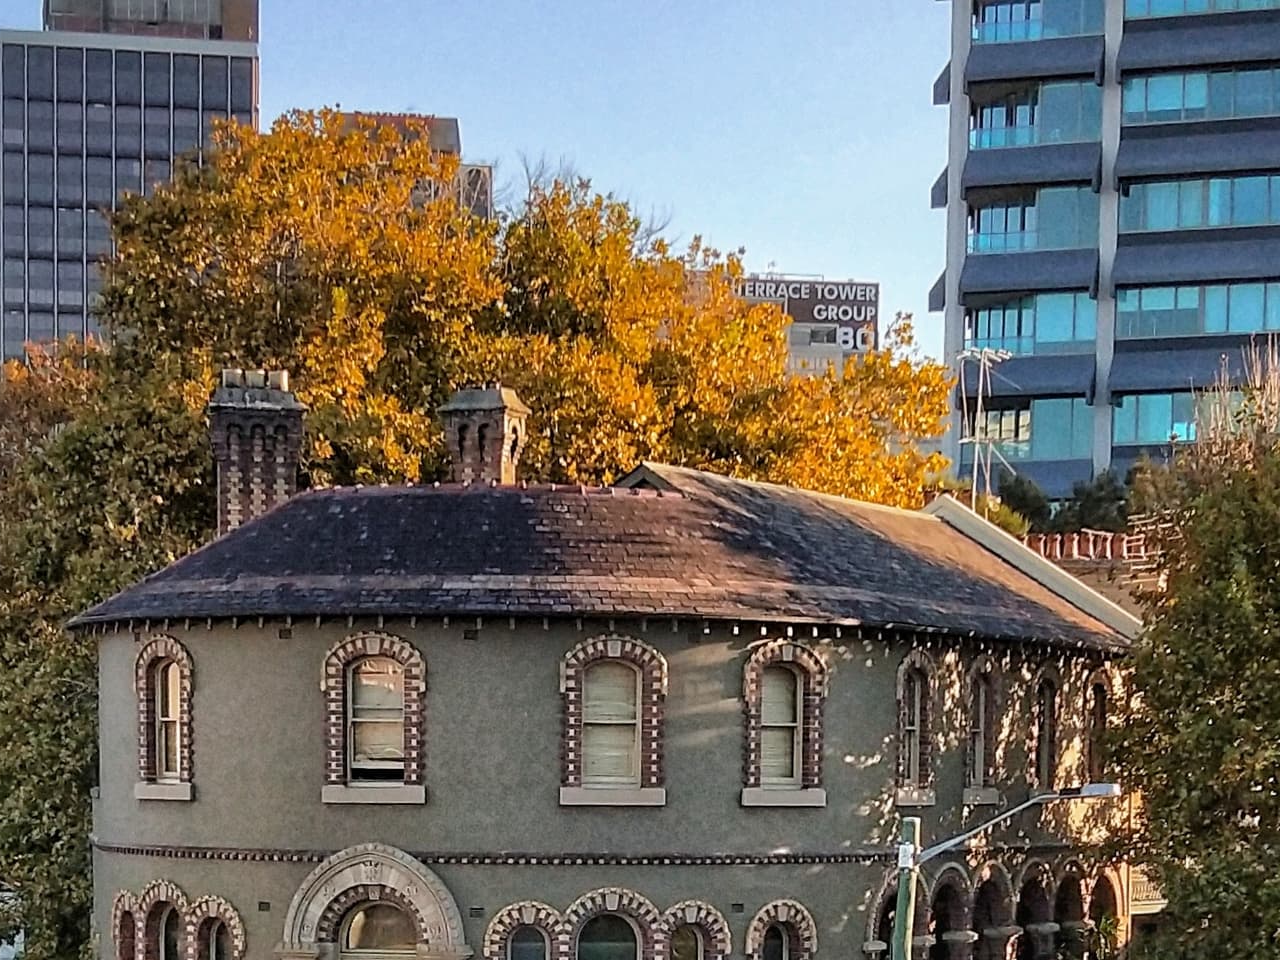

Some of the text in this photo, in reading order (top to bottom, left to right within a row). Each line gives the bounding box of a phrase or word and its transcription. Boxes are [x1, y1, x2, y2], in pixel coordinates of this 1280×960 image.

[734, 282, 876, 301] TERRACE TOWER
[813, 304, 876, 321] GROUP
